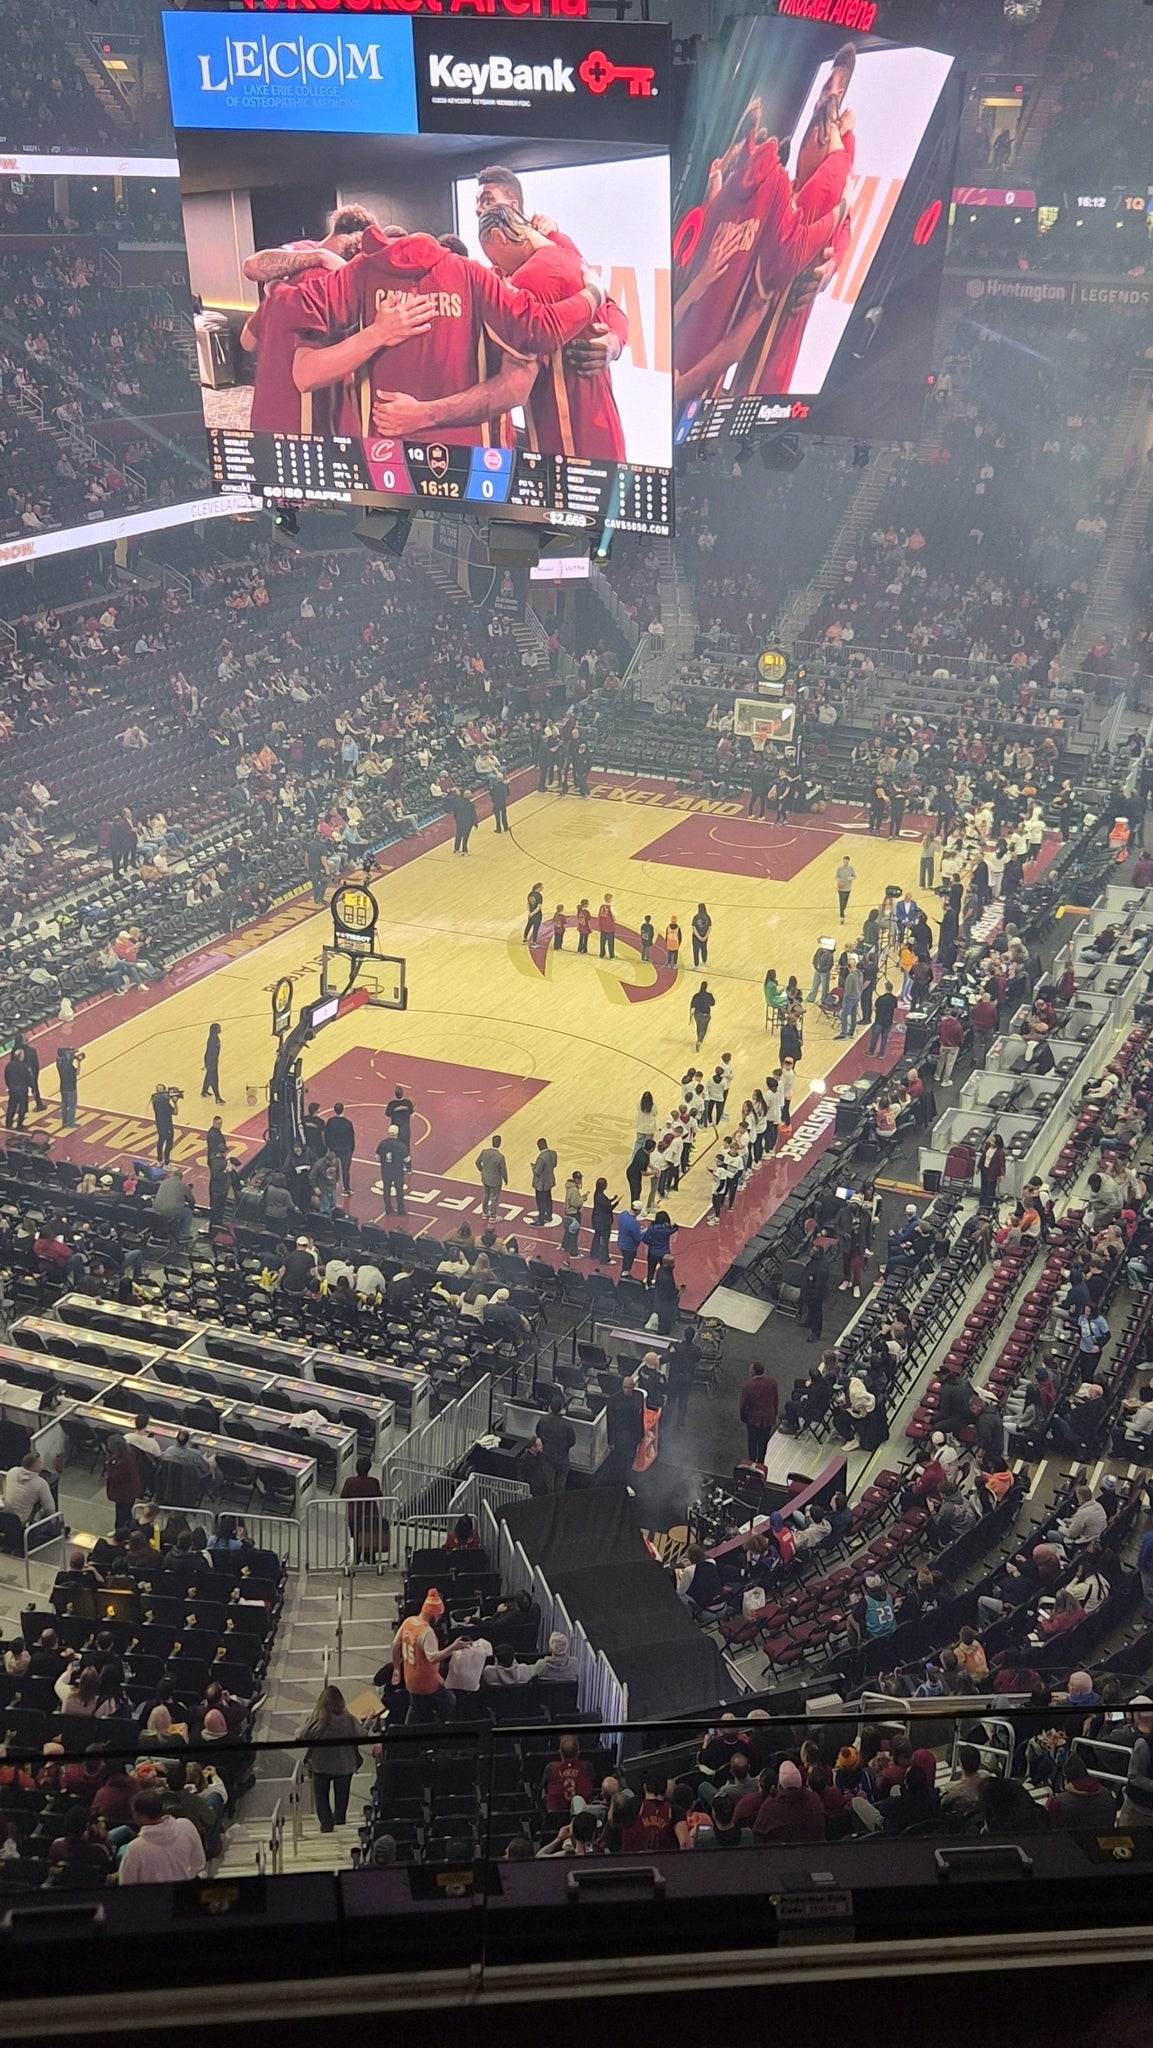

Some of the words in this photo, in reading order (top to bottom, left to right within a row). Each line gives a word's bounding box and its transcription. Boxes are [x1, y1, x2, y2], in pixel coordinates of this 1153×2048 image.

[429, 54, 576, 95] KeyBank
[243, 84, 270, 96] LAKE
[271, 86, 292, 97] ERIE
[295, 86, 339, 97] COLLEGE
[226, 96, 240, 107] OF
[242, 97, 311, 108] OSTEOPATHIC
[1077, 196, 1107, 208] 16:12
[1125, 197, 1145, 211] 1Q
[986, 279, 1065, 302] Huntington
[1081, 288, 1150, 304] LEGENDS
[408, 448, 424, 461] 1Q
[383, 470, 395, 488] 0
[305, 489, 352, 502] RAFFLE
[420, 480, 460, 498] 16:12
[482, 480, 494, 498] 0
[549, 511, 587, 528] $2,669
[604, 518, 669, 536] CAVS5050.COM
[876, 1605, 894, 1625] 23
